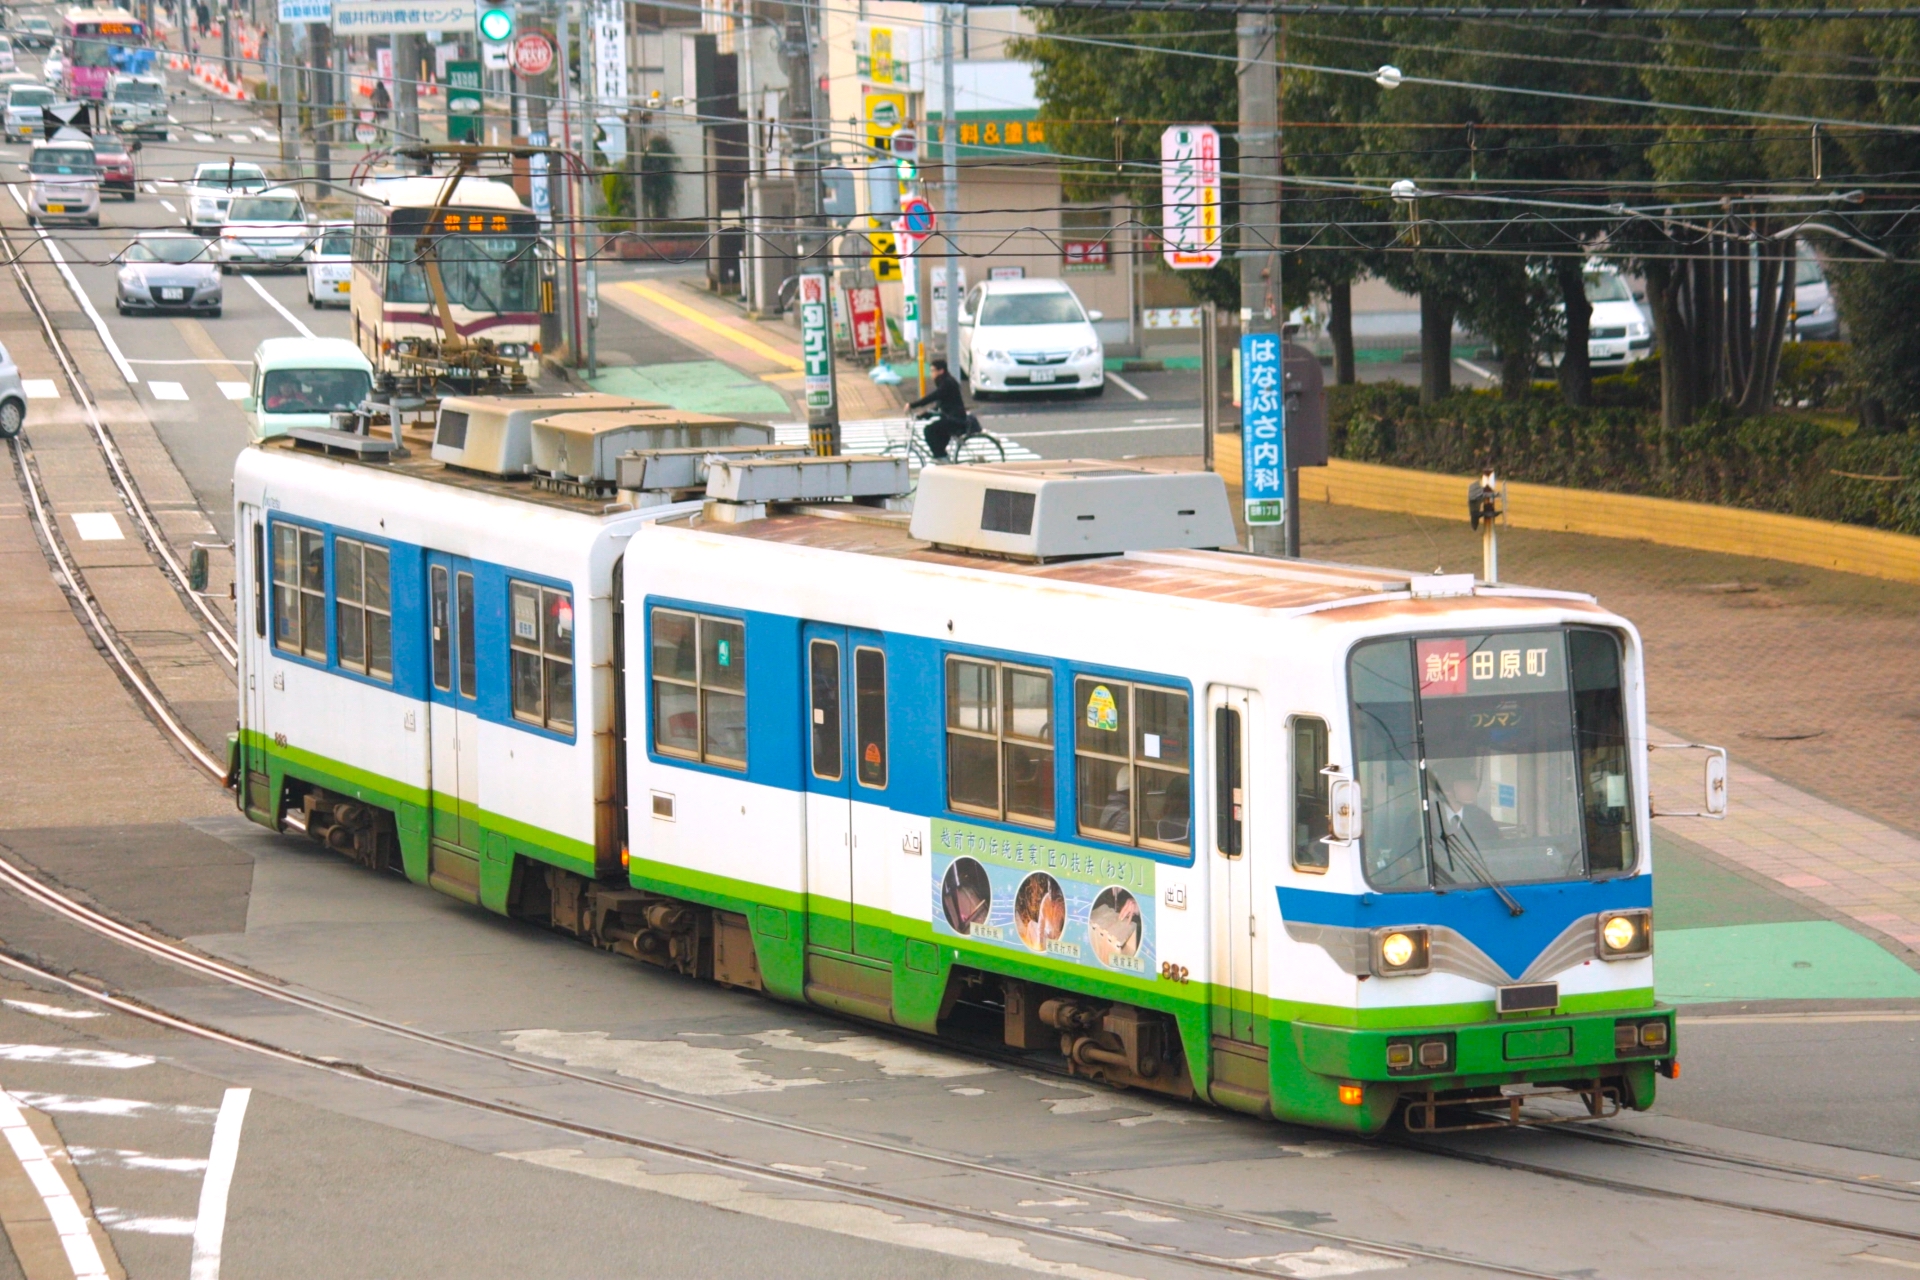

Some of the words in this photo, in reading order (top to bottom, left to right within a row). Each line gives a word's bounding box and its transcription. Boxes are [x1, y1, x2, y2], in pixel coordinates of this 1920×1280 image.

[339, 8, 475, 25] 福井市消費者センター
[938, 121, 1046, 146] 料&塗装
[803, 305, 827, 374] タケイ
[1250, 338, 1280, 493] はなぶさ内科
[1425, 652, 1460, 682] 急行
[1472, 648, 1548, 680] 田原町
[1470, 711, 1522, 728] ワンマン
[275, 732, 287, 748] 883
[904, 835, 919, 850] 入口
[1166, 886, 1184, 904] 出口
[1161, 960, 1189, 985] 882
